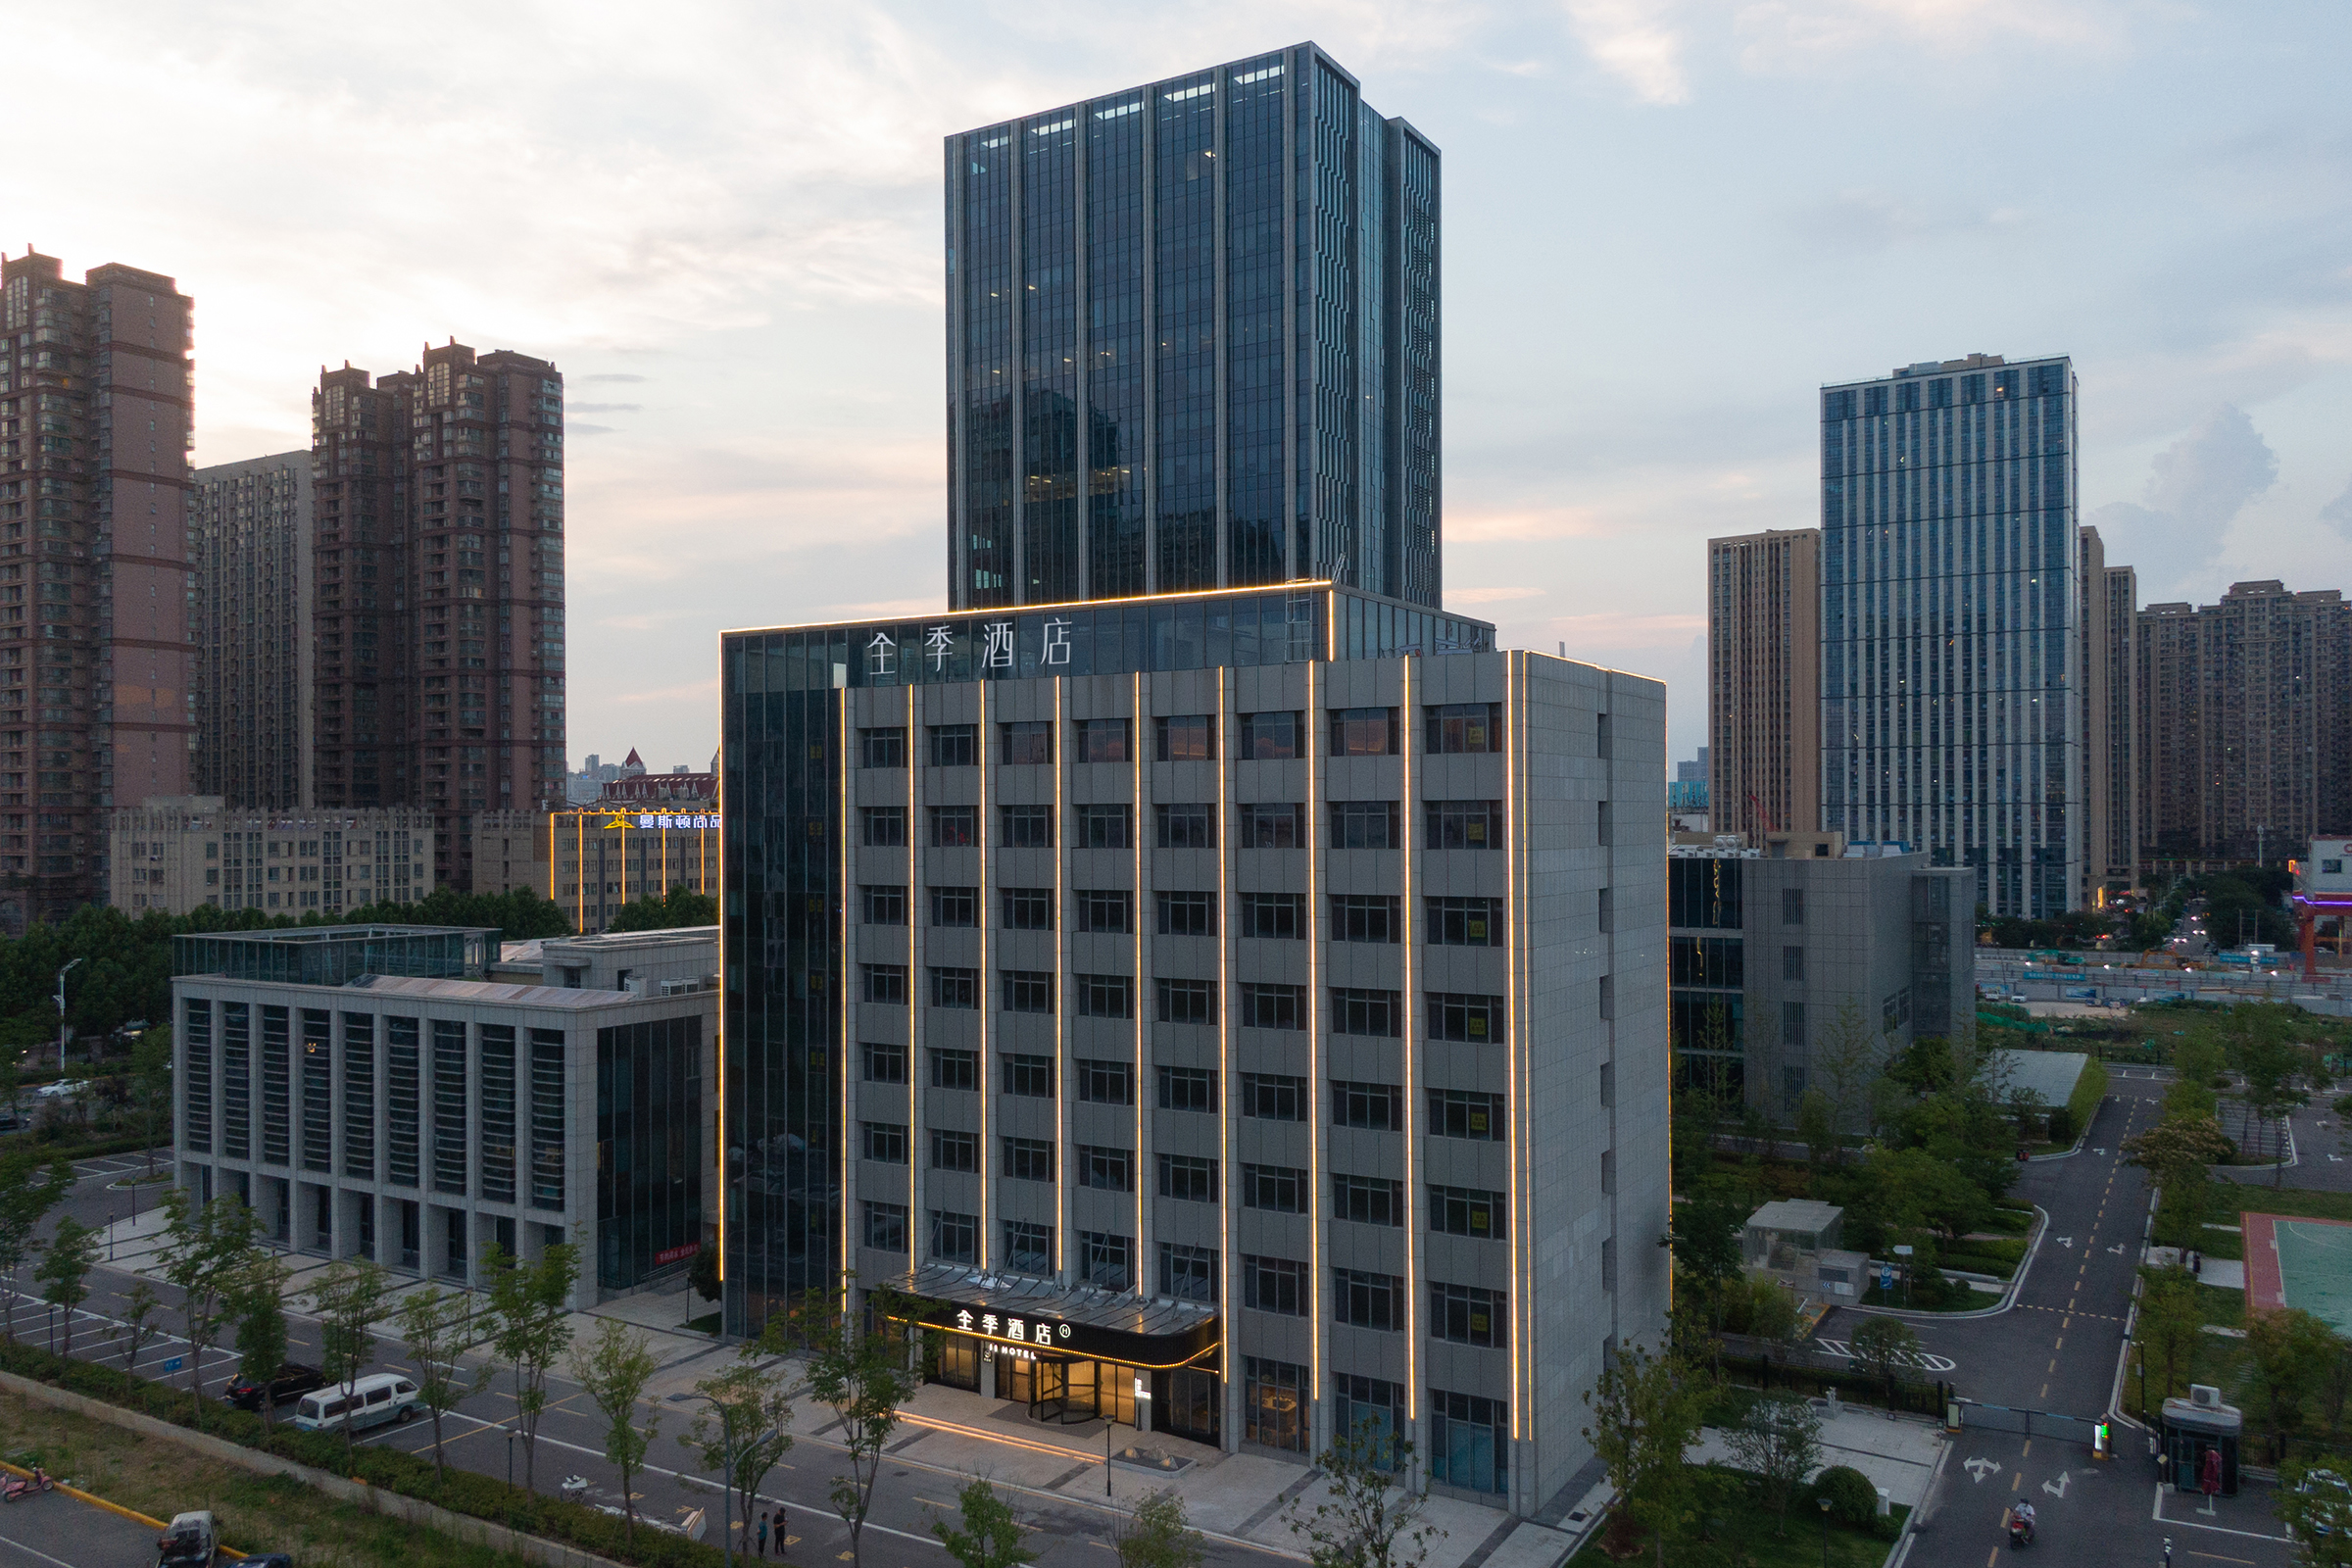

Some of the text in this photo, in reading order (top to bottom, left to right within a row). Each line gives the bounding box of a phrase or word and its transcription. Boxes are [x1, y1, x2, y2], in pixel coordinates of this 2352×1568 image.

[867, 617, 1072, 675] 全季酒店
[640, 814, 720, 829] 曼斯顿尚品
[956, 1309, 1052, 1346] 全季酒店
[1002, 1346, 1037, 1360] HOTEL
